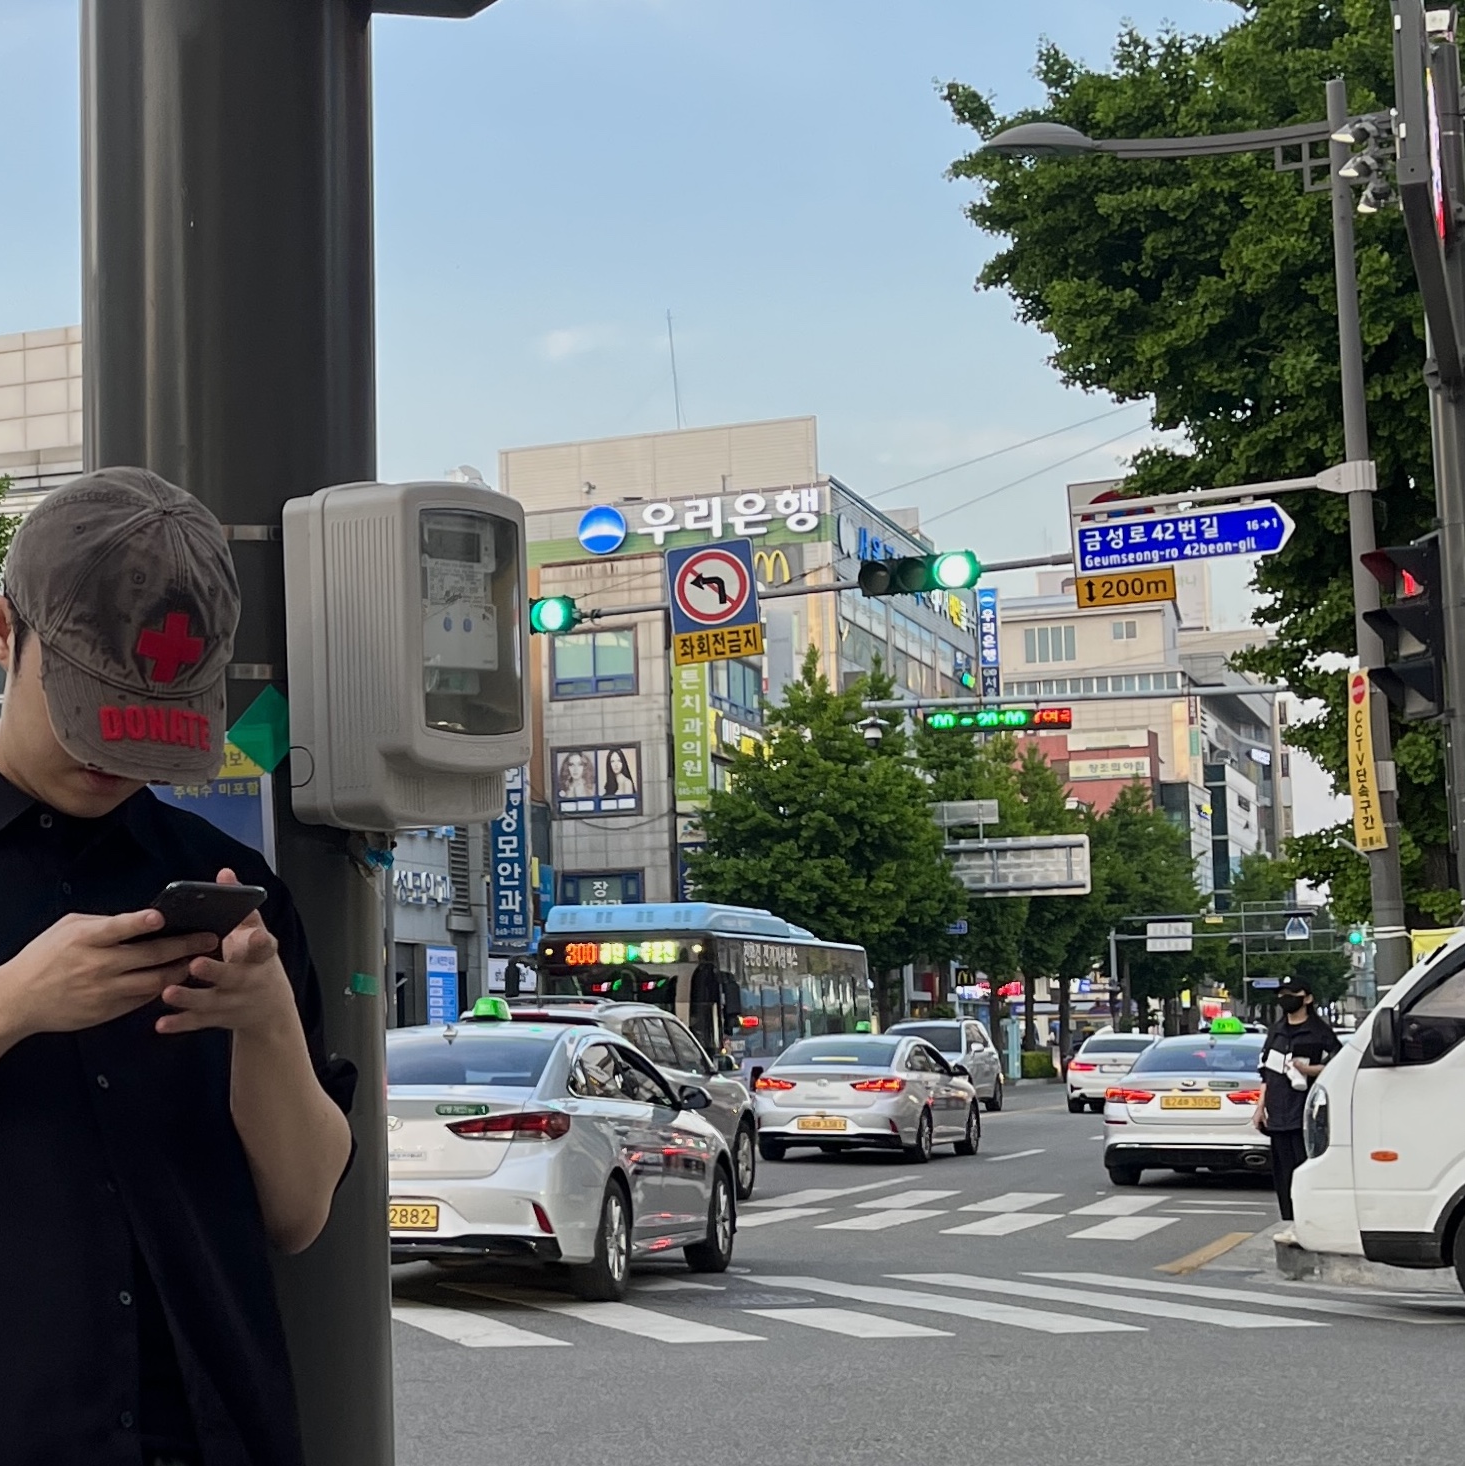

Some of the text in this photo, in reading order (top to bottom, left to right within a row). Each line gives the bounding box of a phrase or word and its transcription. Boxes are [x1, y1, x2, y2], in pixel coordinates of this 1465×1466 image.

[637, 487, 819, 545] 우리은행
[1083, 516, 1219, 551] 금성로 42번길
[1246, 520, 1258, 531] 16
[1085, 536, 1256, 568] Geumseong-ro 42beon-gil
[1101, 577, 1168, 599] 200m
[679, 626, 758, 660] 좌회전금지
[980, 608, 998, 664] 우리은행
[99, 705, 211, 752] DONATE
[679, 663, 703, 777] 튼치과의원
[1354, 710, 1375, 831] CCTV단속구간
[496, 808, 523, 913] 성모안과
[566, 941, 598, 966] 300
[390, 1208, 431, 1224] 2882
